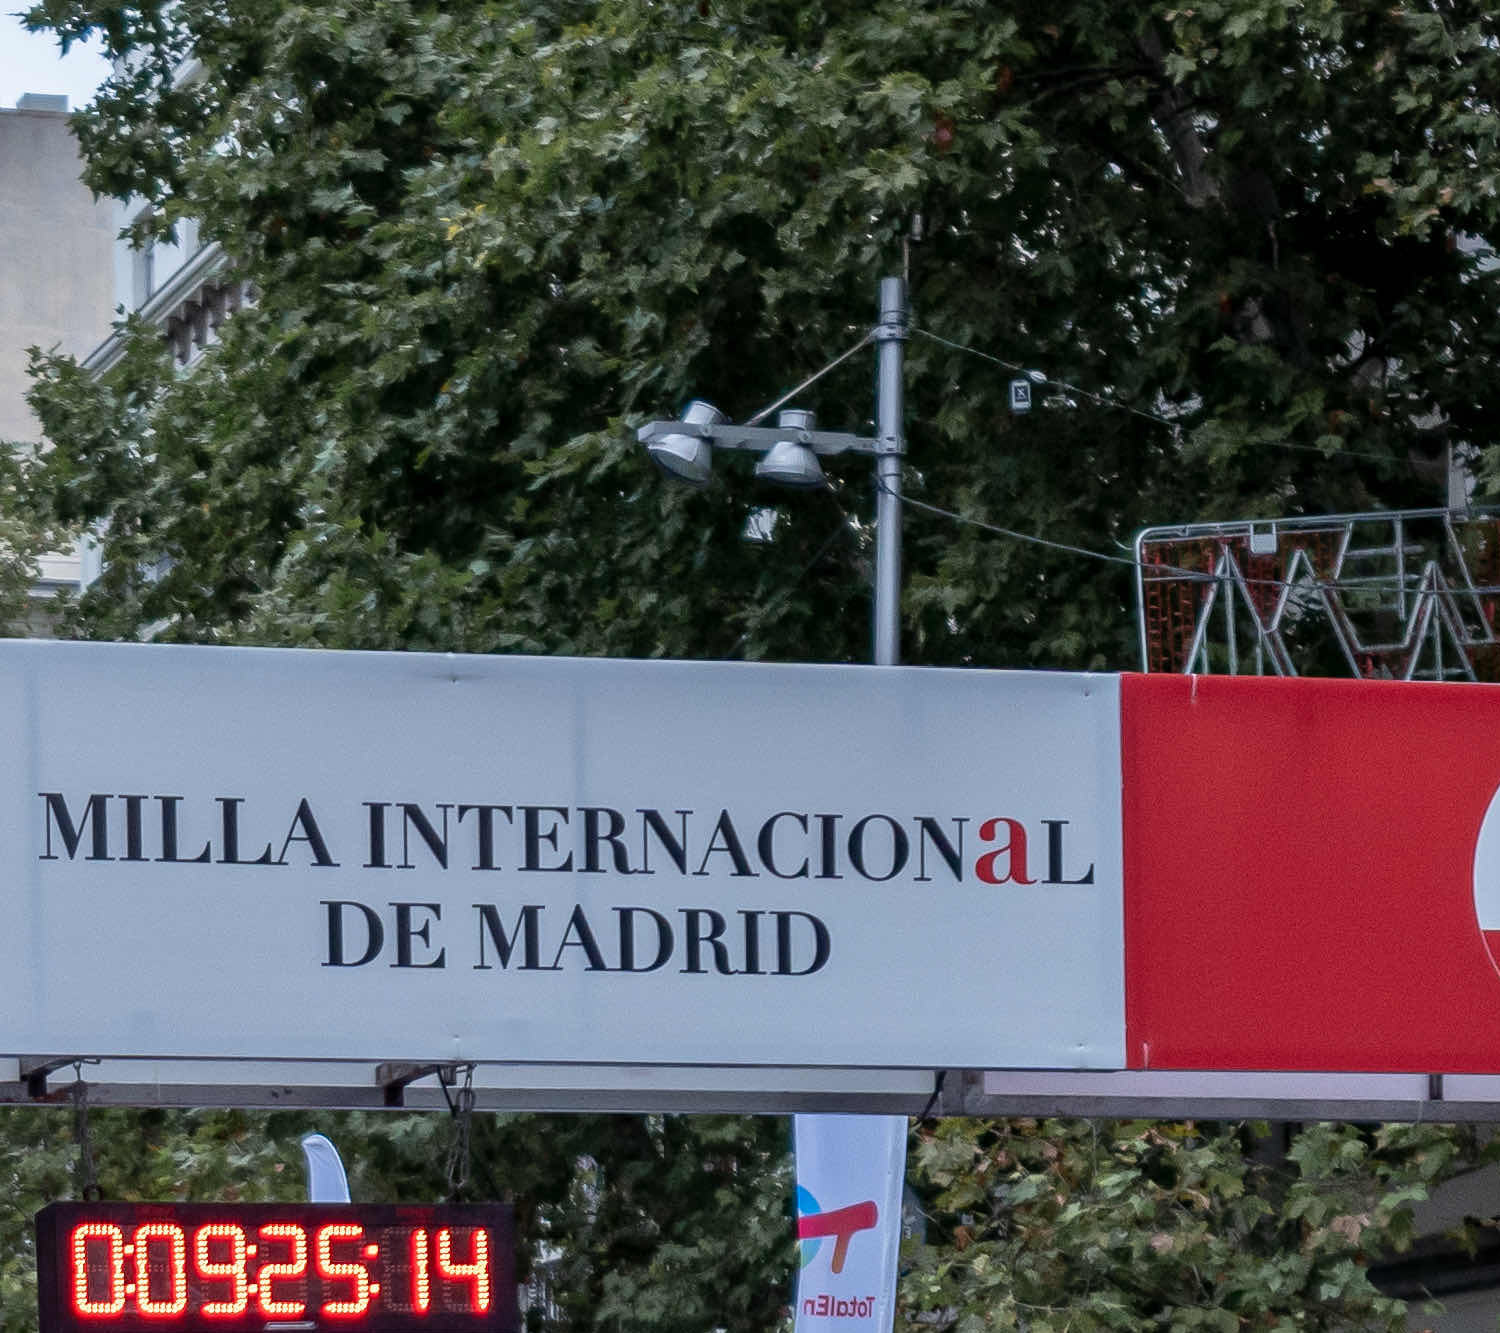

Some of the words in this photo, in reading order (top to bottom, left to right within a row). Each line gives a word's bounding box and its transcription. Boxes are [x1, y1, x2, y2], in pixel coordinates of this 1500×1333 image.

[40, 792, 340, 871] MILLA
[321, 897, 448, 972] DE
[473, 904, 832, 979] MADRID
